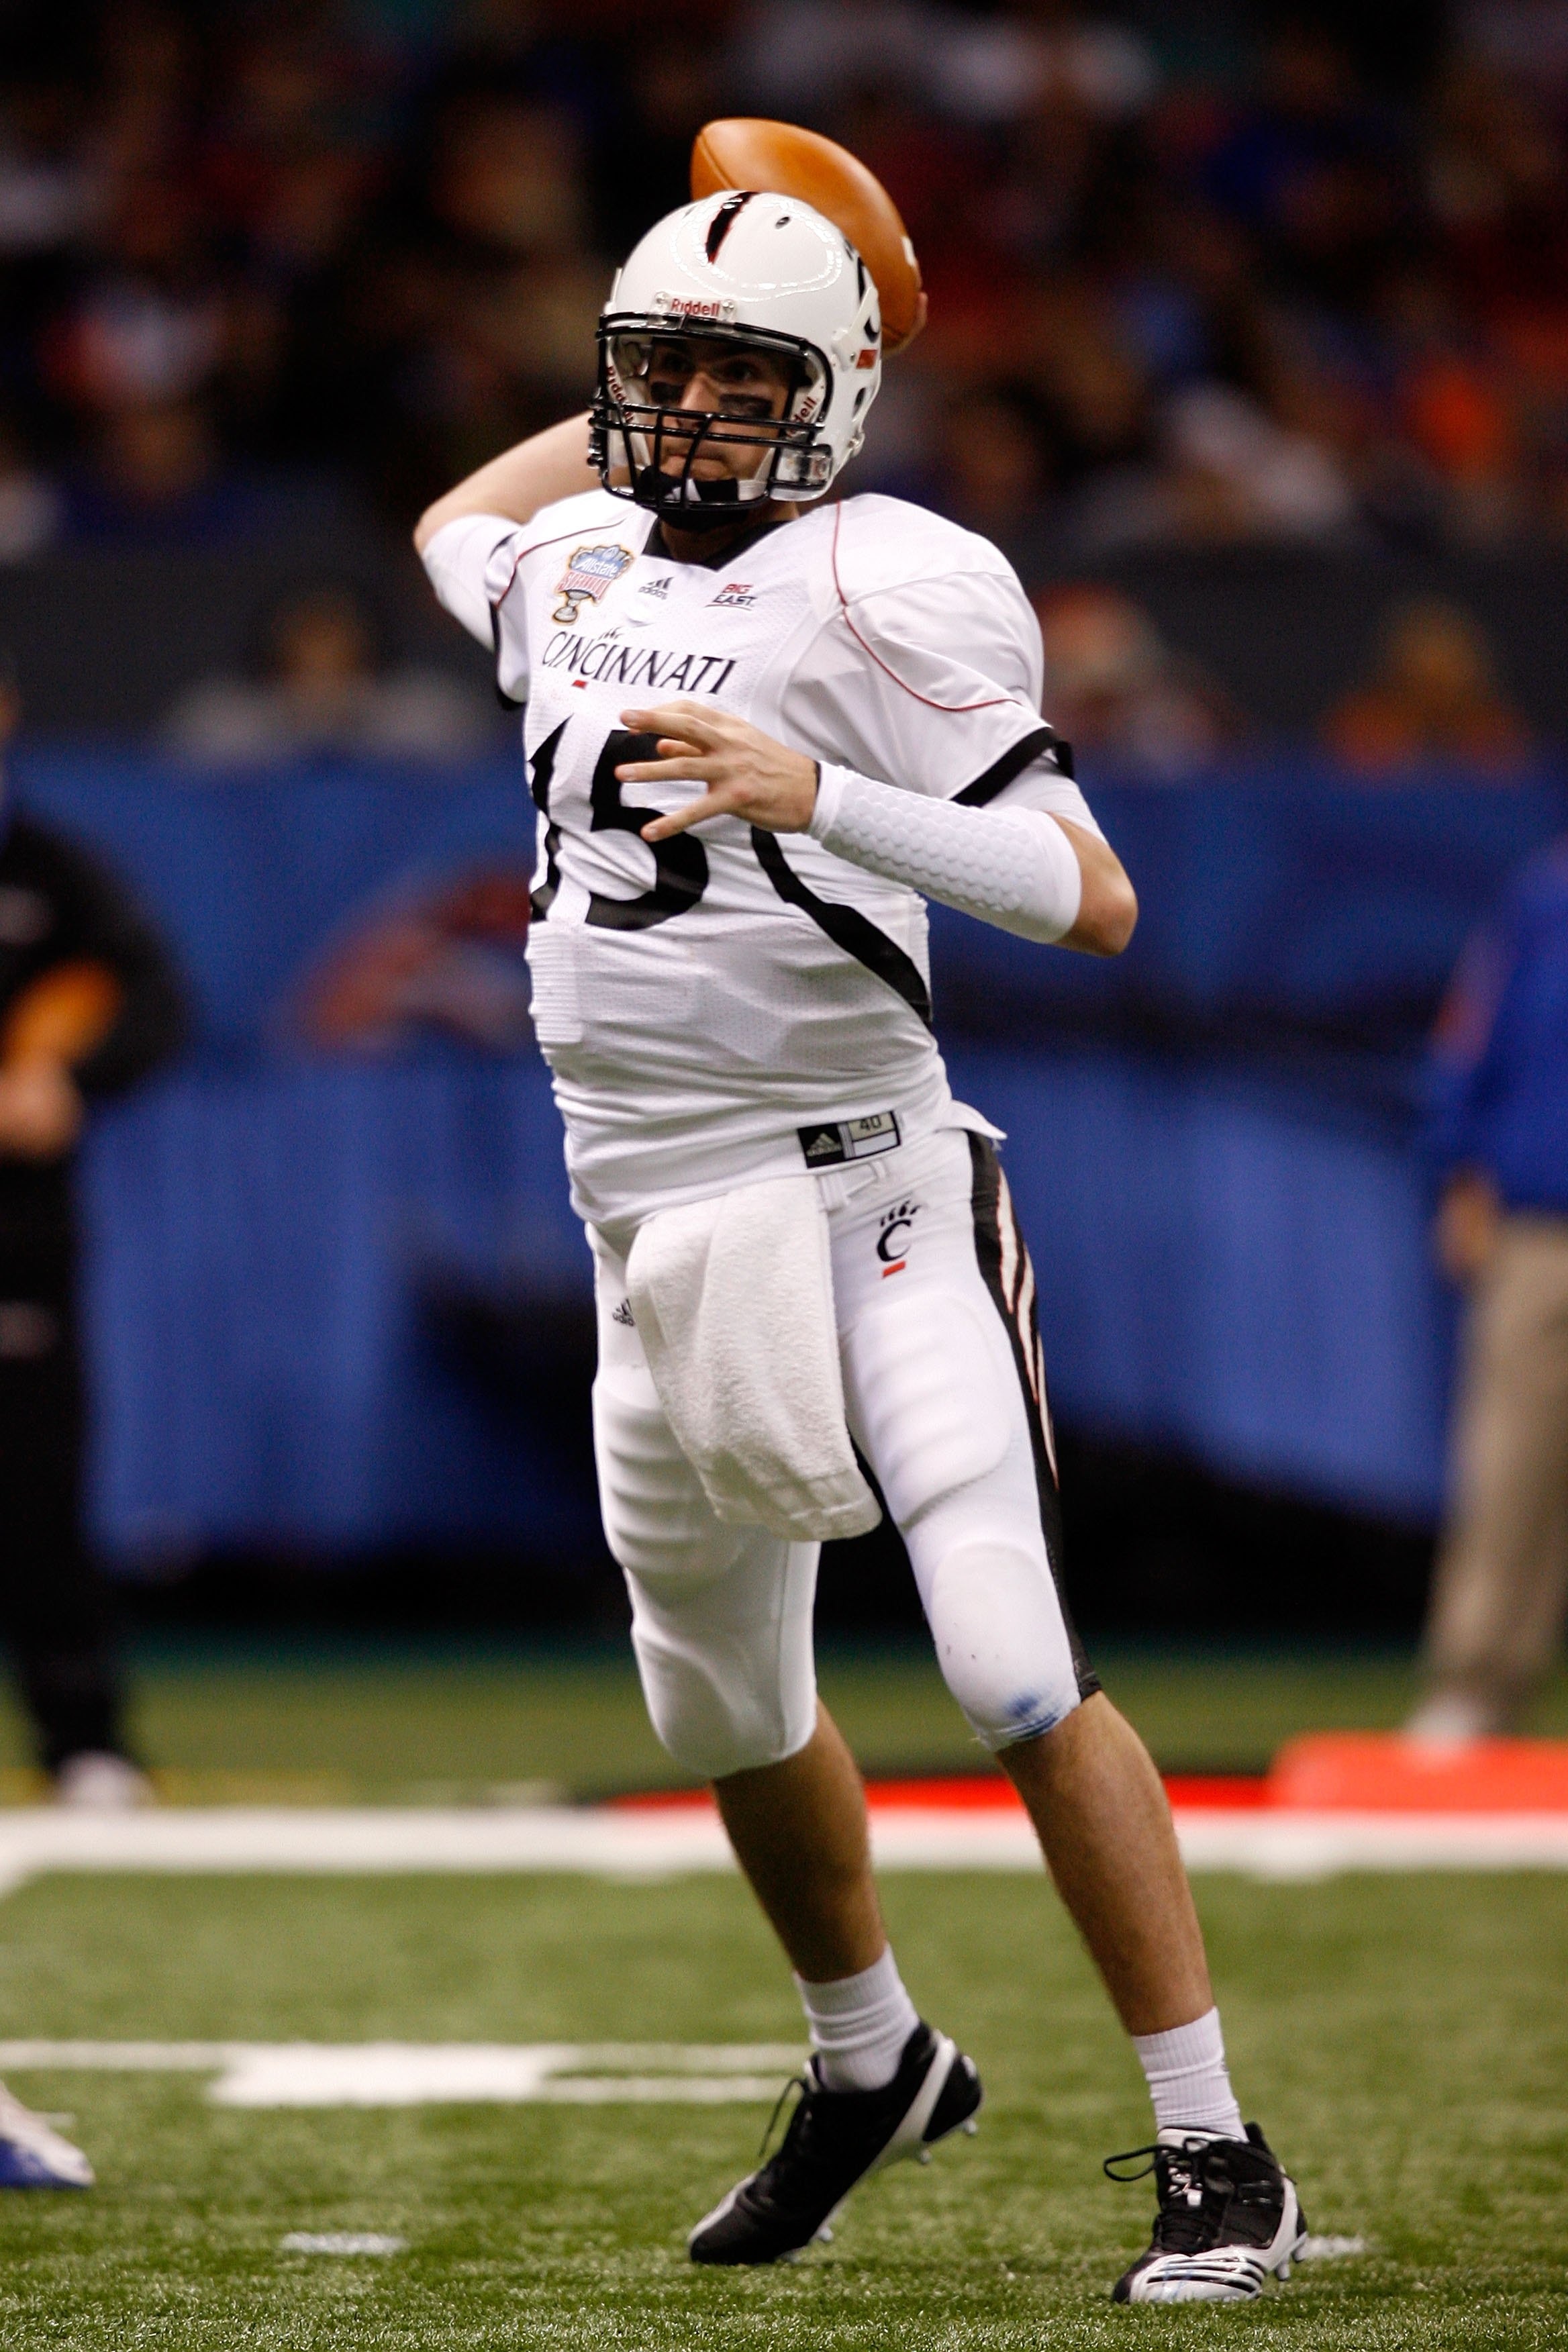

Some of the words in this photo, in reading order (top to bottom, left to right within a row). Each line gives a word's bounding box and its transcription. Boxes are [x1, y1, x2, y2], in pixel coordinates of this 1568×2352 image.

[672, 298, 720, 317] Riddell
[575, 558, 618, 577] Allstate
[722, 584, 752, 594] BIG
[712, 594, 757, 605] EAST
[542, 631, 737, 695] CINCINNATI
[528, 714, 709, 930] 15
